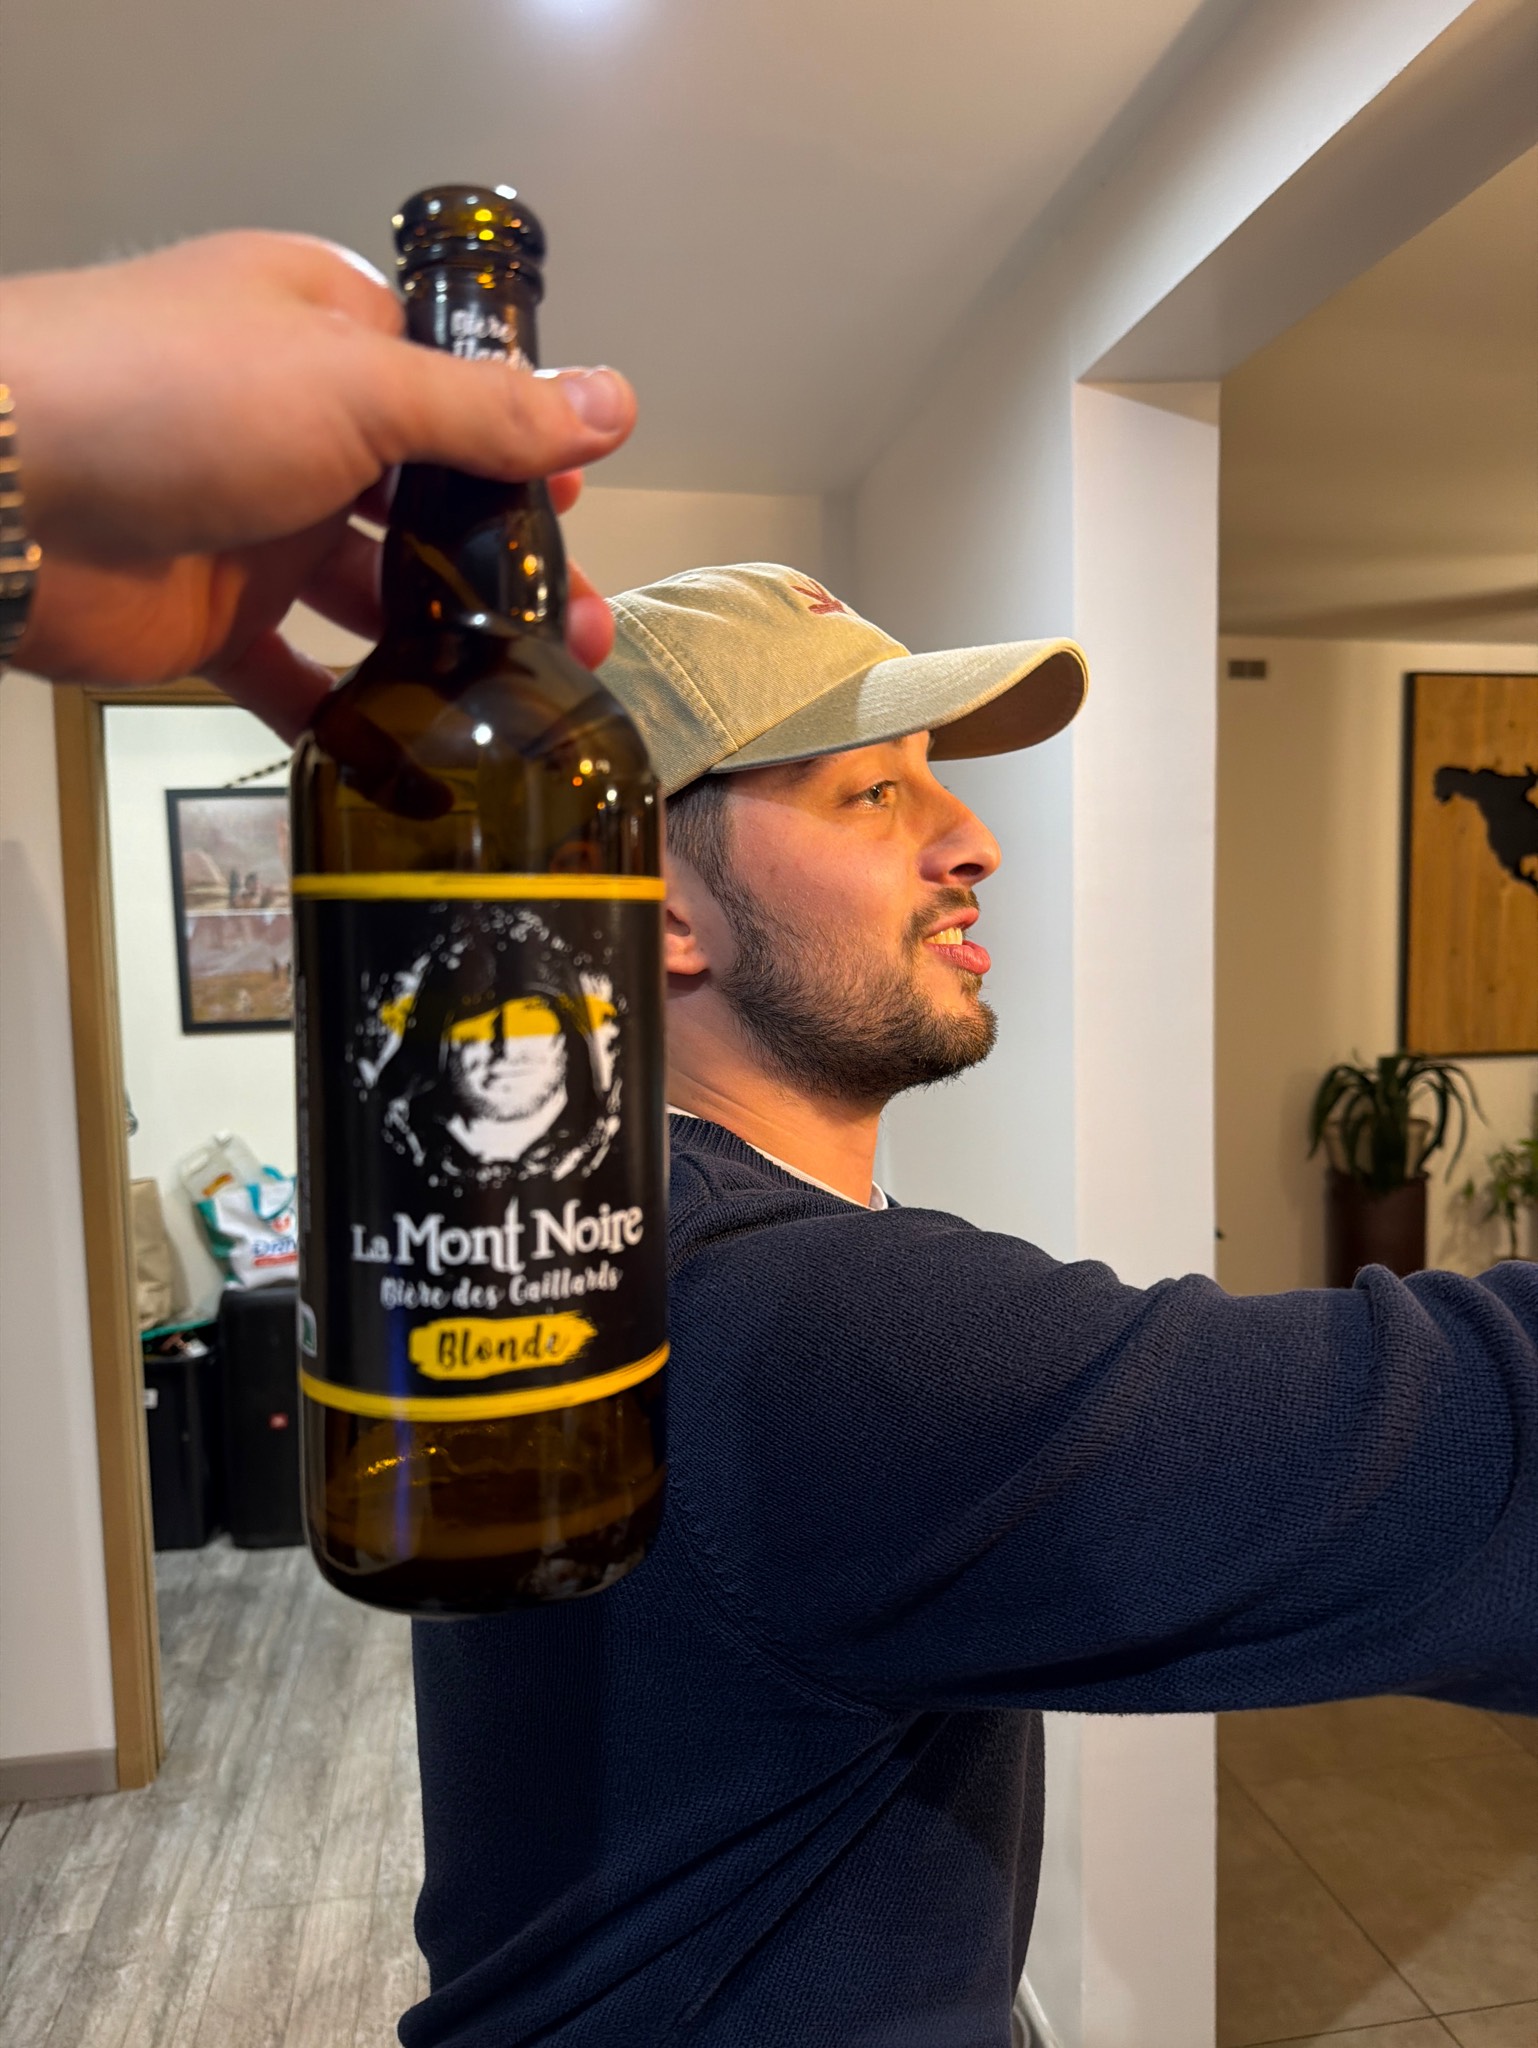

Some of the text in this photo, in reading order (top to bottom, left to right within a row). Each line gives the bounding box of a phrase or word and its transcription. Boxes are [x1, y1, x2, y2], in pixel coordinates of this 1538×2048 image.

[351, 1197, 644, 1275] La Mont Noire
[452, 1277, 504, 1310] des
[436, 1323, 562, 1369] Blonde
